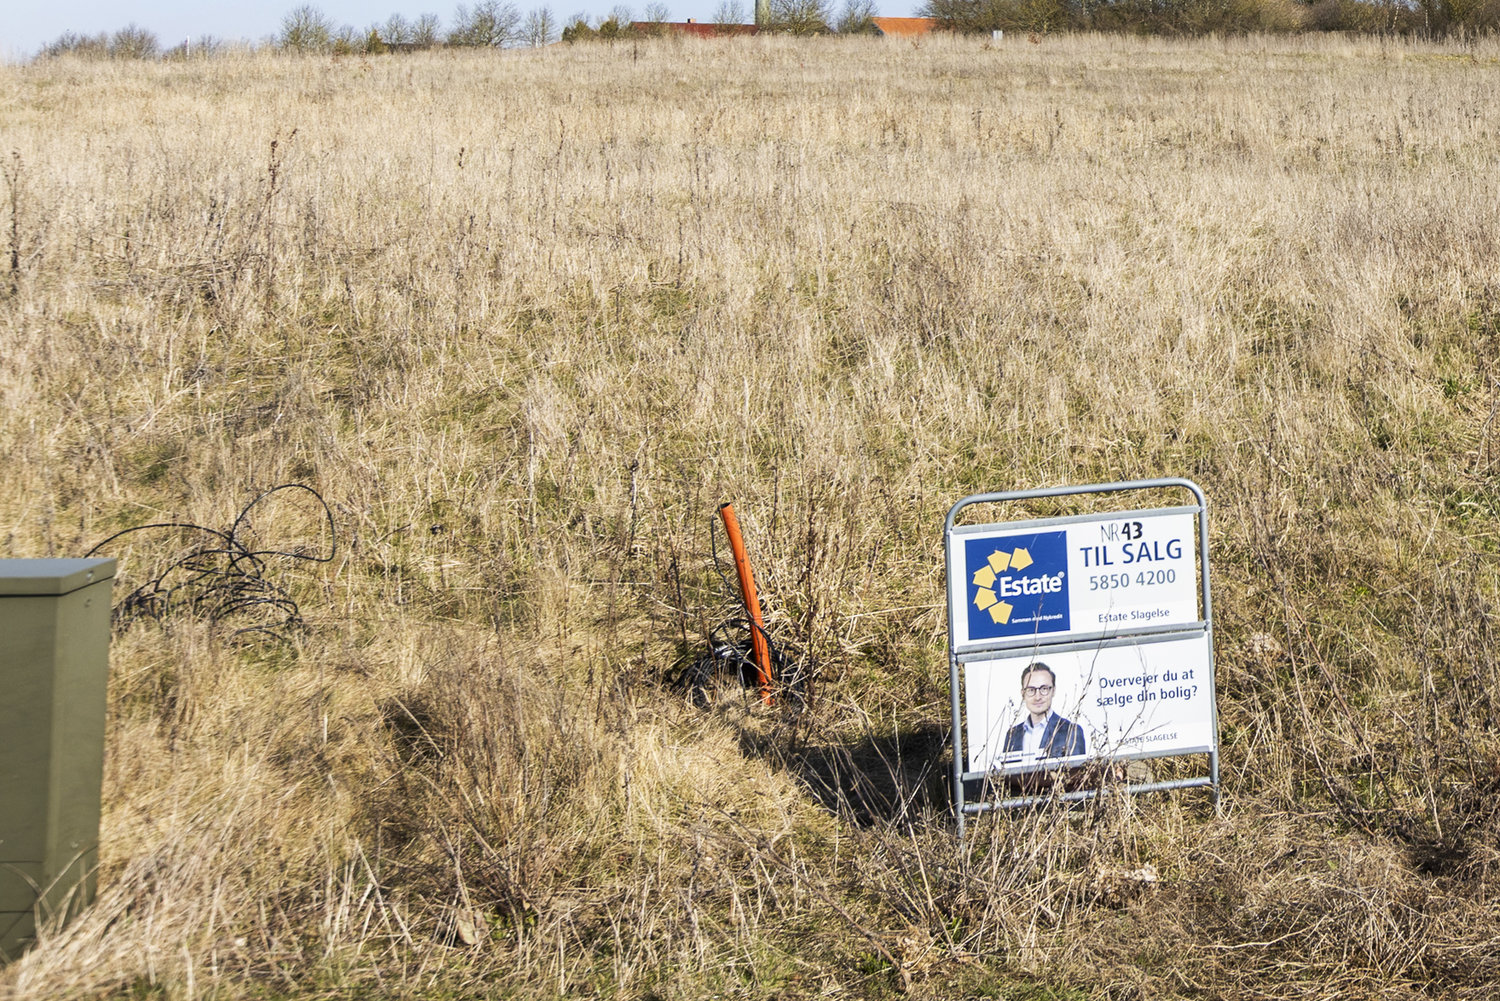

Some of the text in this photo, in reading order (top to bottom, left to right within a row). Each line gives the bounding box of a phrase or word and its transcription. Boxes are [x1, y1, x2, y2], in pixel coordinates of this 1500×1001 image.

[1101, 521, 1143, 542] NR 43
[1080, 538, 1182, 568] TIL SALG
[1089, 568, 1176, 591] 5850 4200
[1098, 608, 1170, 623] Estate Slagelse
[1099, 669, 1194, 689] Overvejer du at
[1096, 685, 1198, 708] sælge din bolig?
[1145, 732, 1178, 743] SLAGELSE
